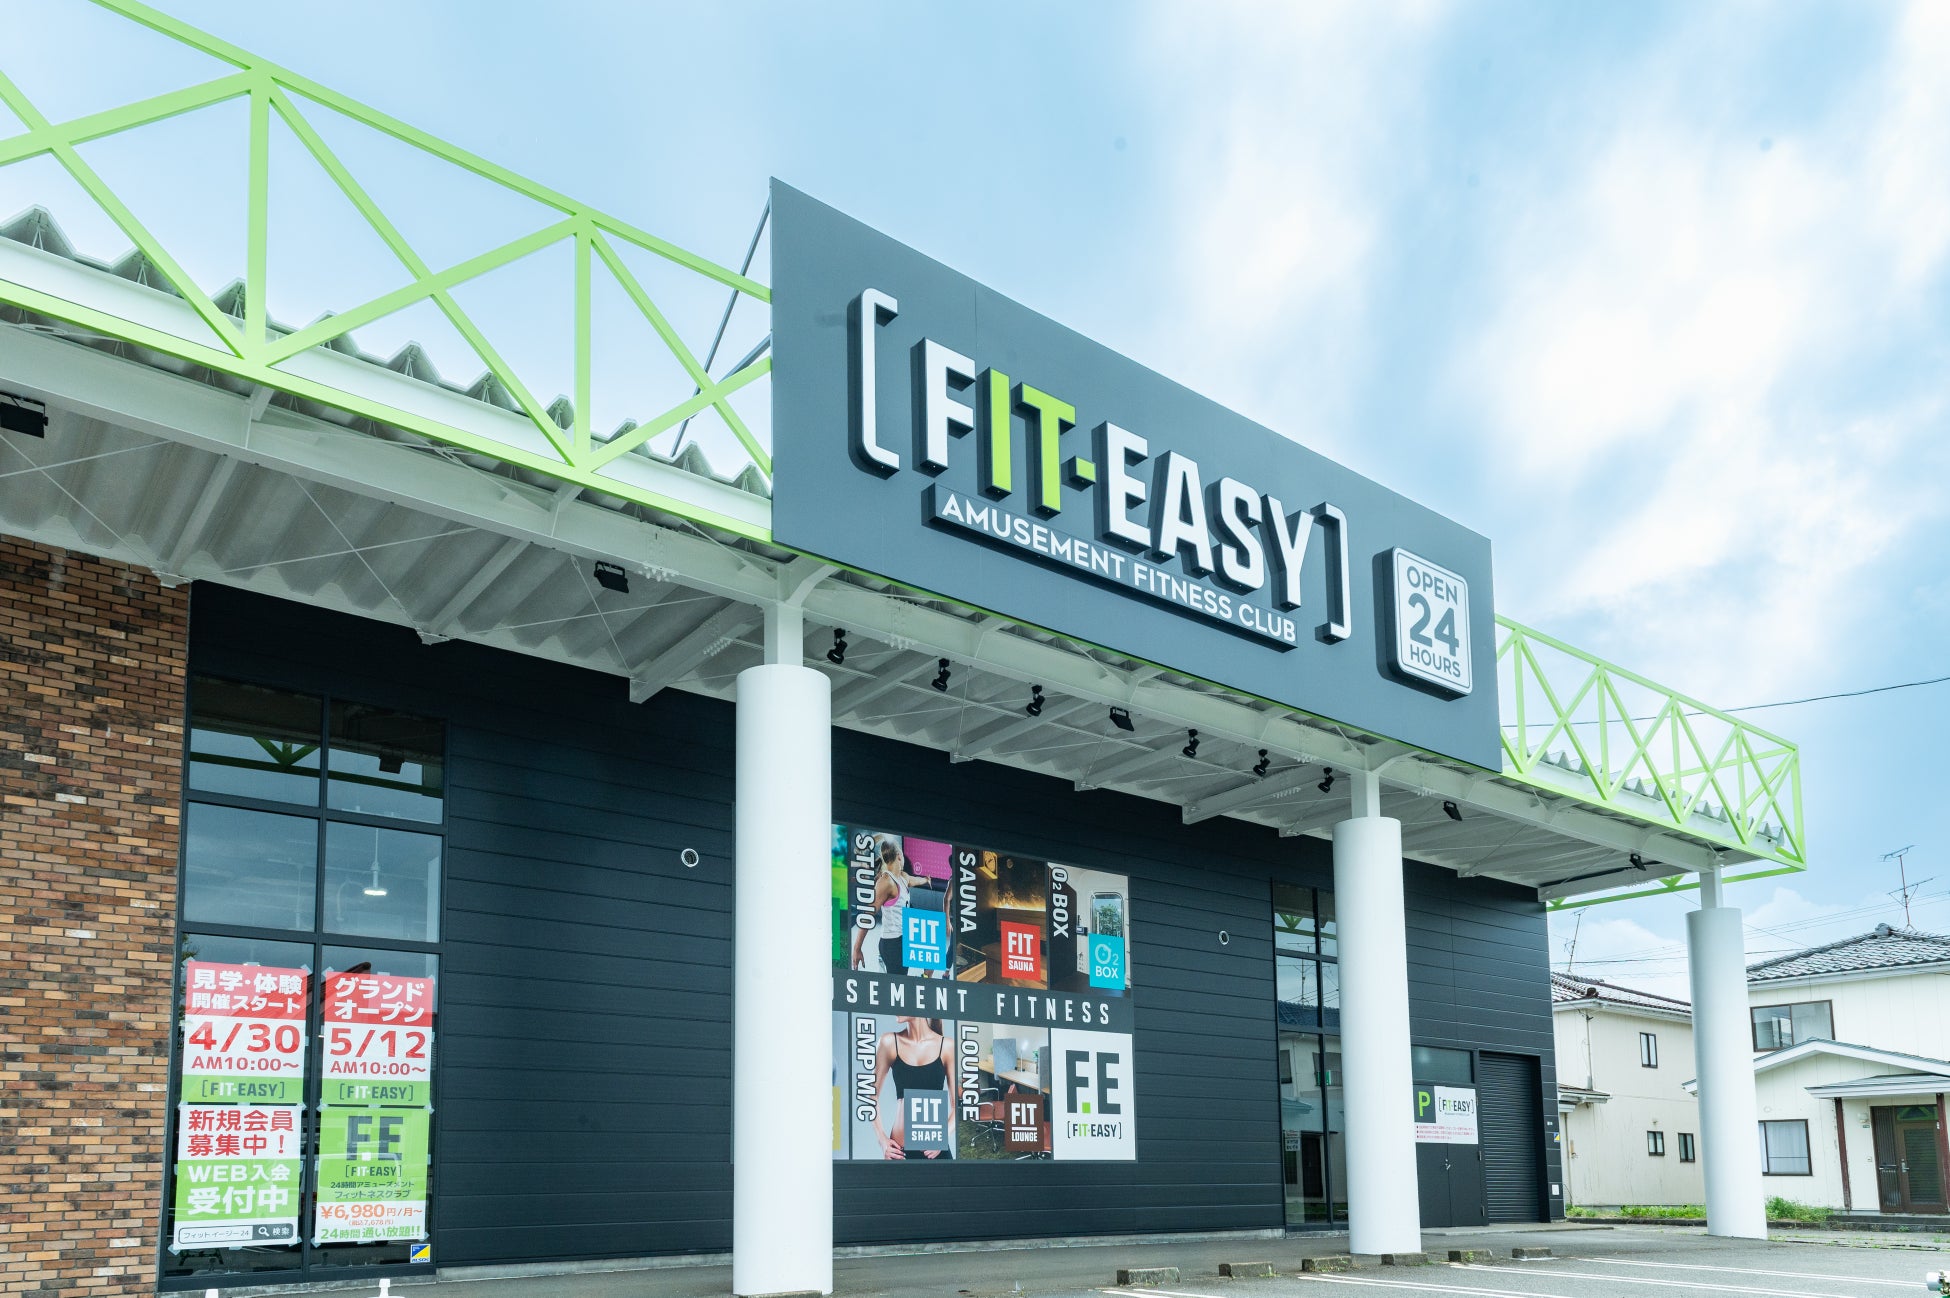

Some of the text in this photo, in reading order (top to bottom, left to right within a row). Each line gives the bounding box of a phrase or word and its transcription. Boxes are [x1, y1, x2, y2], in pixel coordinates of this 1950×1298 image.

[942, 494, 1297, 643] AMUSEMENT FITNESS CLUB
[1407, 566, 1458, 605] OPEN
[1408, 592, 1460, 657] 24
[1410, 644, 1461, 678] HOURS
[855, 833, 876, 930] STUDIO
[959, 851, 977, 933] SAUNA
[908, 918, 940, 944] FIT
[1007, 932, 1035, 956] FIT
[909, 949, 940, 964] AERO
[1008, 959, 1034, 973] SAUNA
[192, 968, 303, 996] 見学・体験
[1095, 965, 1119, 979] BOX
[191, 991, 301, 1014] 開催スタート
[334, 977, 425, 1002] グランド
[832, 977, 1110, 1025] SEMENT FITNESS
[334, 999, 425, 1023] オープン
[189, 1021, 301, 1053] 4/30
[330, 1027, 426, 1058] 5/12
[857, 1017, 877, 1121] EMP M/C
[960, 1025, 980, 1122] LOUNGE
[911, 1097, 942, 1122] FIT
[1011, 1103, 1037, 1125] FIT
[1418, 1091, 1431, 1117] P
[188, 1109, 294, 1133] 新規会員
[911, 1130, 943, 1142] SHAPE
[1011, 1131, 1038, 1143] LOUNGE
[187, 1163, 291, 1183] WEB入会
[187, 1184, 289, 1216] 受付中
